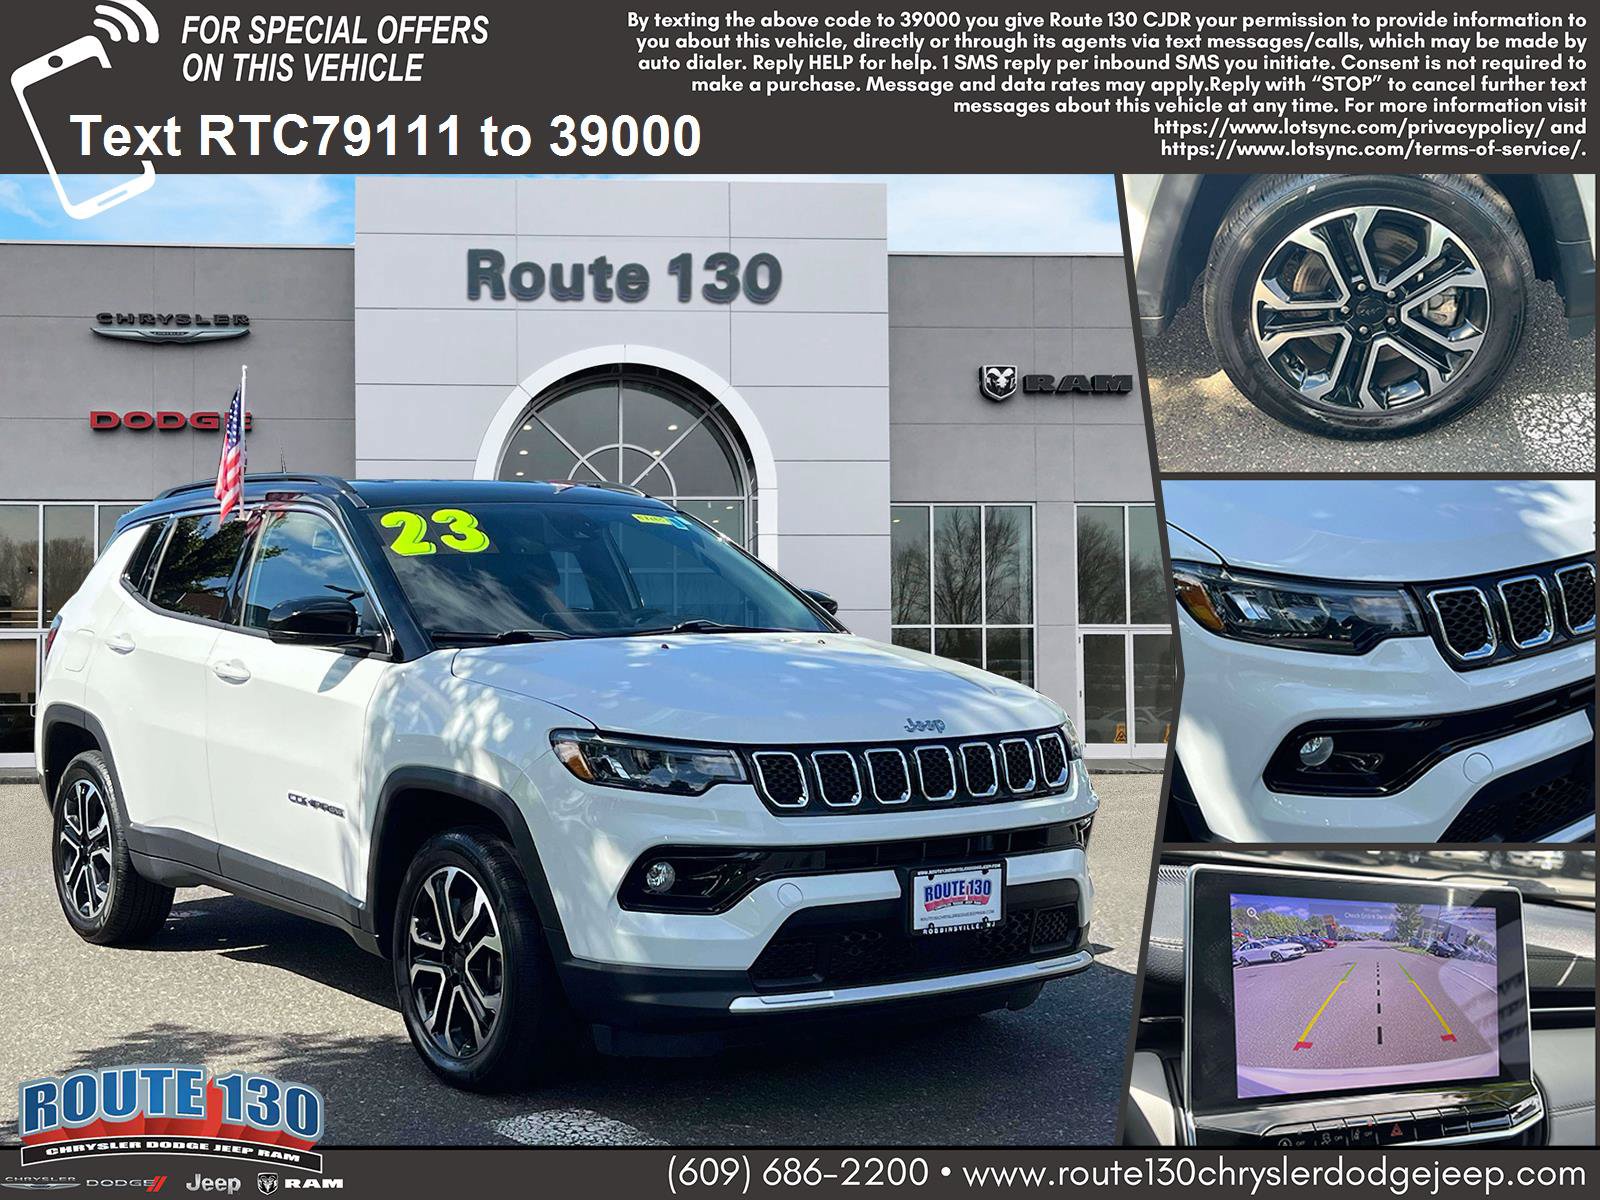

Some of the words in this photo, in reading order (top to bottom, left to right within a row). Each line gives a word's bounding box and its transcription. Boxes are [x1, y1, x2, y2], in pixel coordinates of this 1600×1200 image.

[467, 248, 651, 302] Route
[668, 252, 782, 304] 130
[96, 312, 250, 326] CHRYSLER
[1023, 375, 1133, 394] RAM
[381, 509, 490, 556] 23
[903, 718, 946, 734] Jeep
[924, 881, 966, 903] ROUTE
[968, 880, 992, 896] 130
